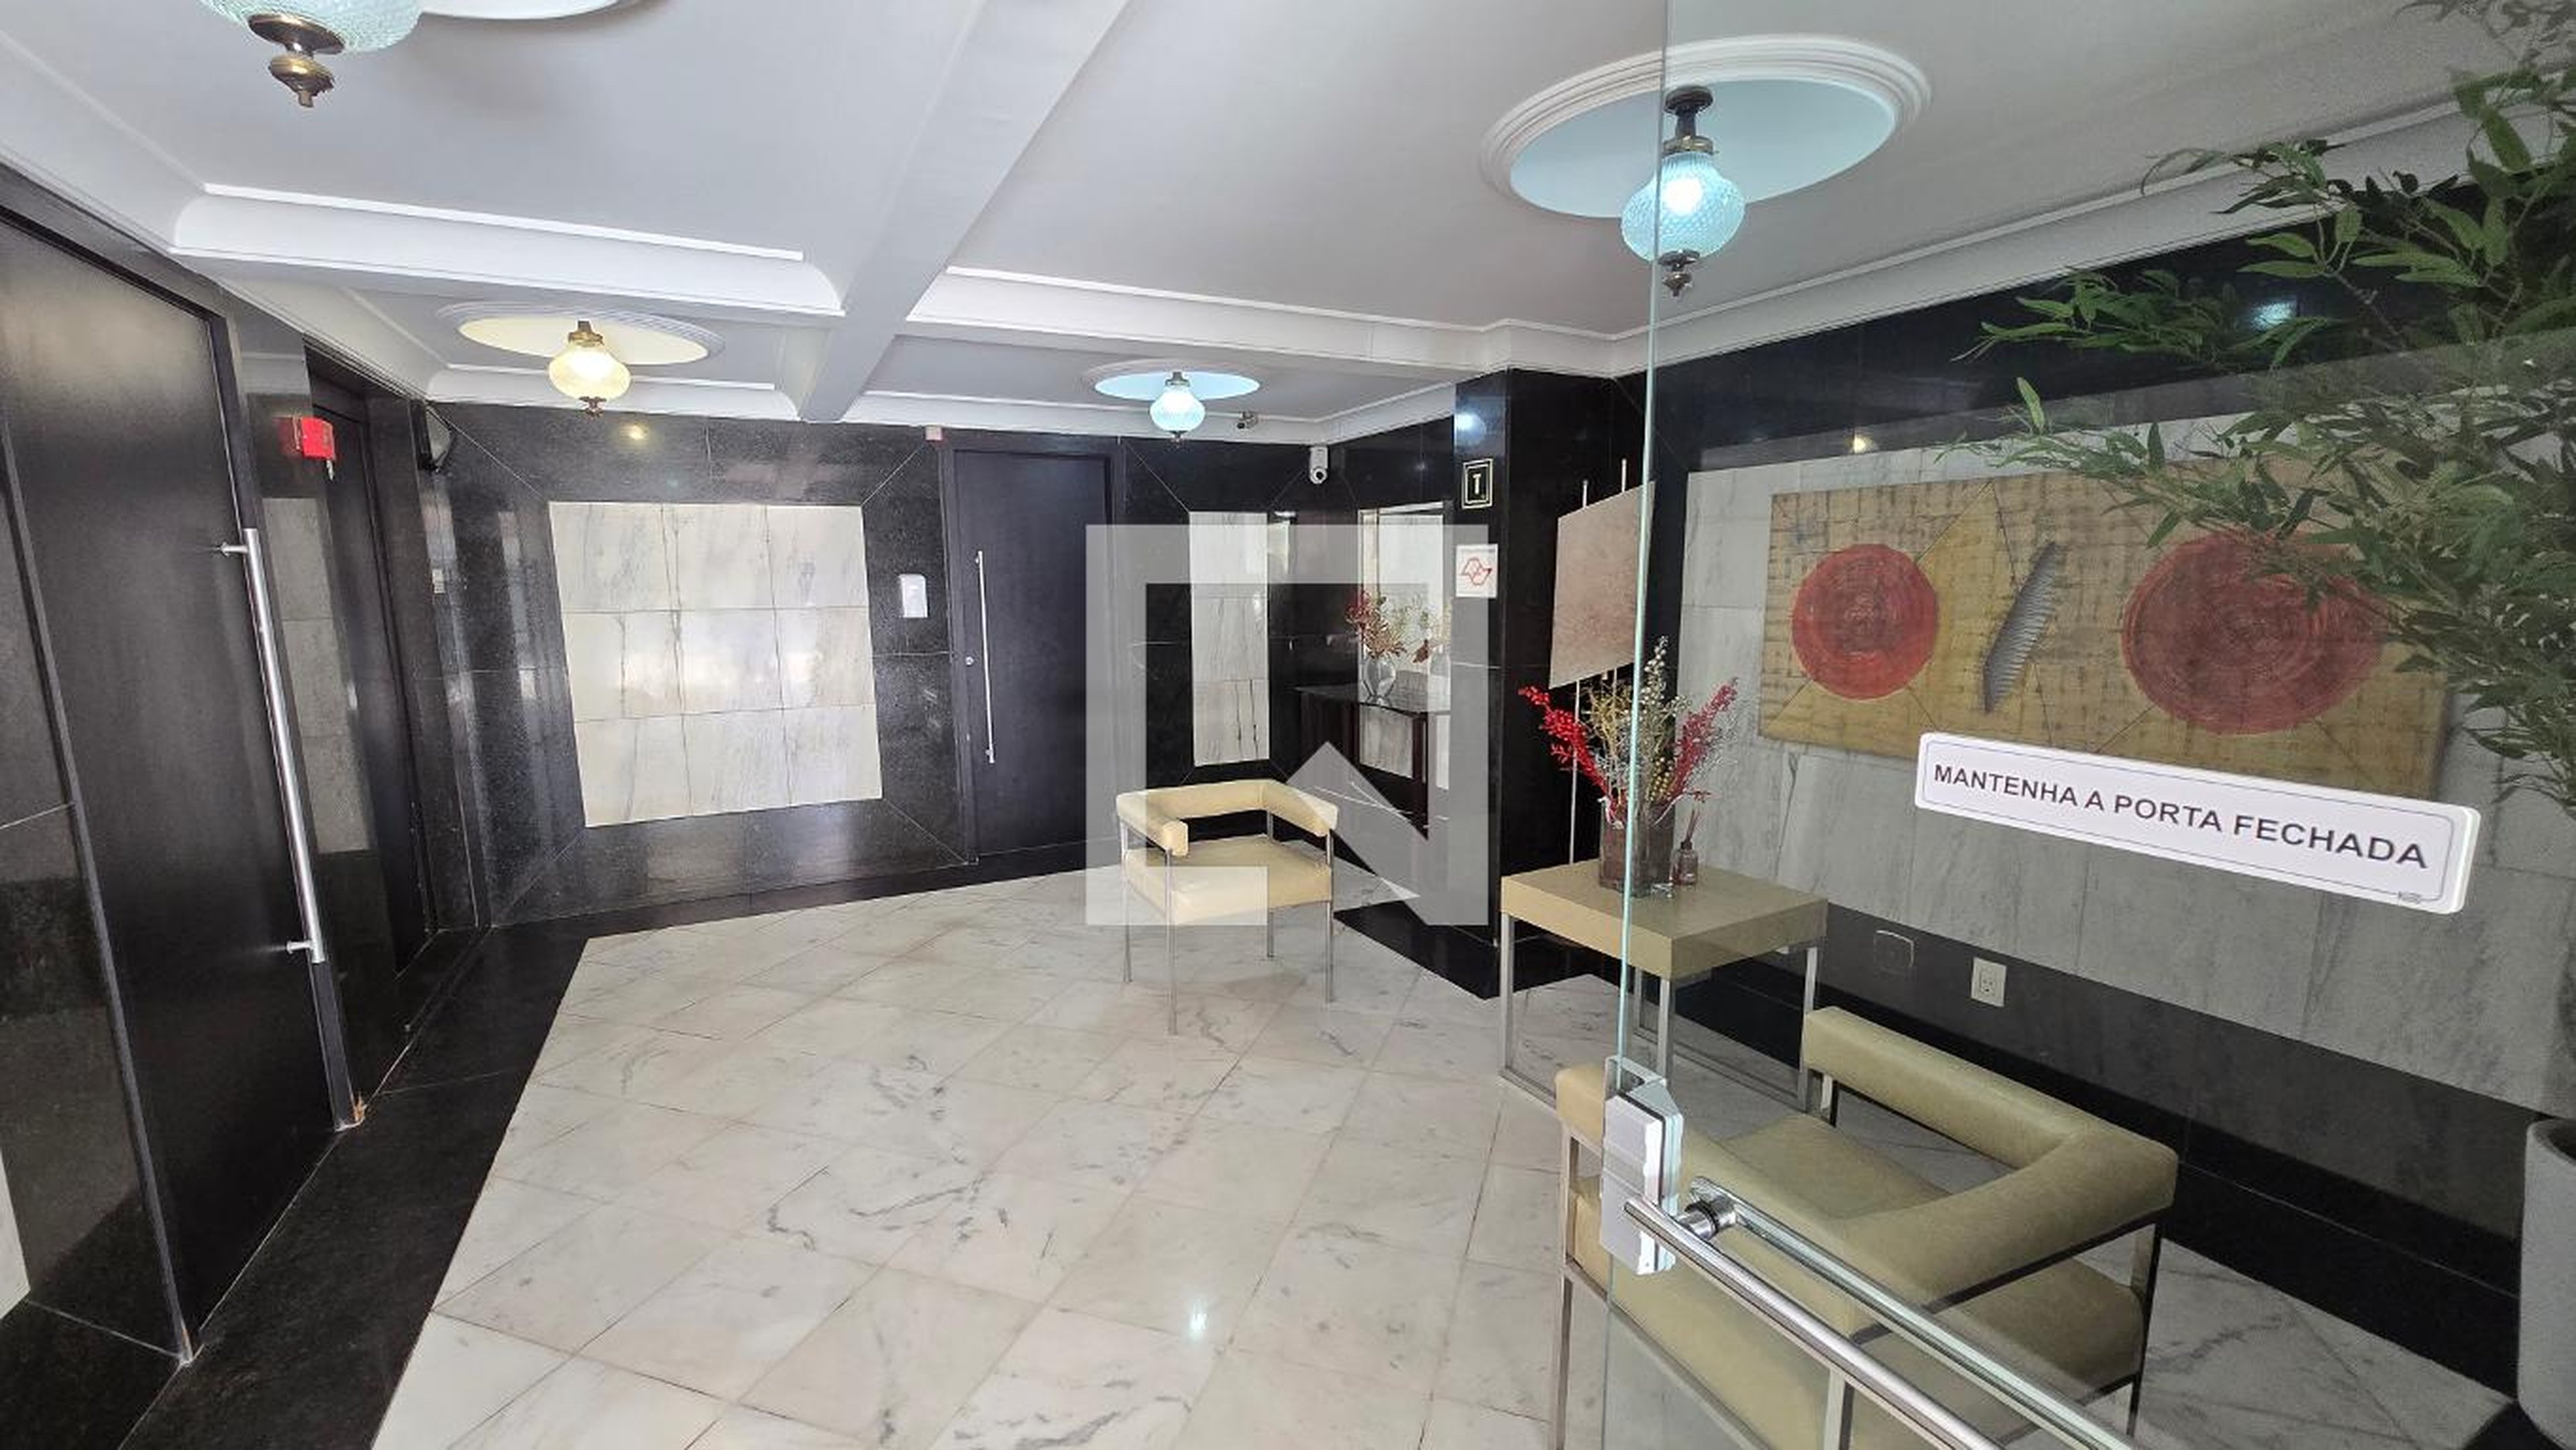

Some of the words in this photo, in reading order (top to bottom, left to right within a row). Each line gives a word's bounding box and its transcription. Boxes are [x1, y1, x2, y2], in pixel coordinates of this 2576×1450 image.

[1934, 764, 2078, 807] MANTENHA
[2084, 790, 2105, 811] A
[2114, 794, 2222, 832] PORTA
[2233, 814, 2428, 869] FECHADA
